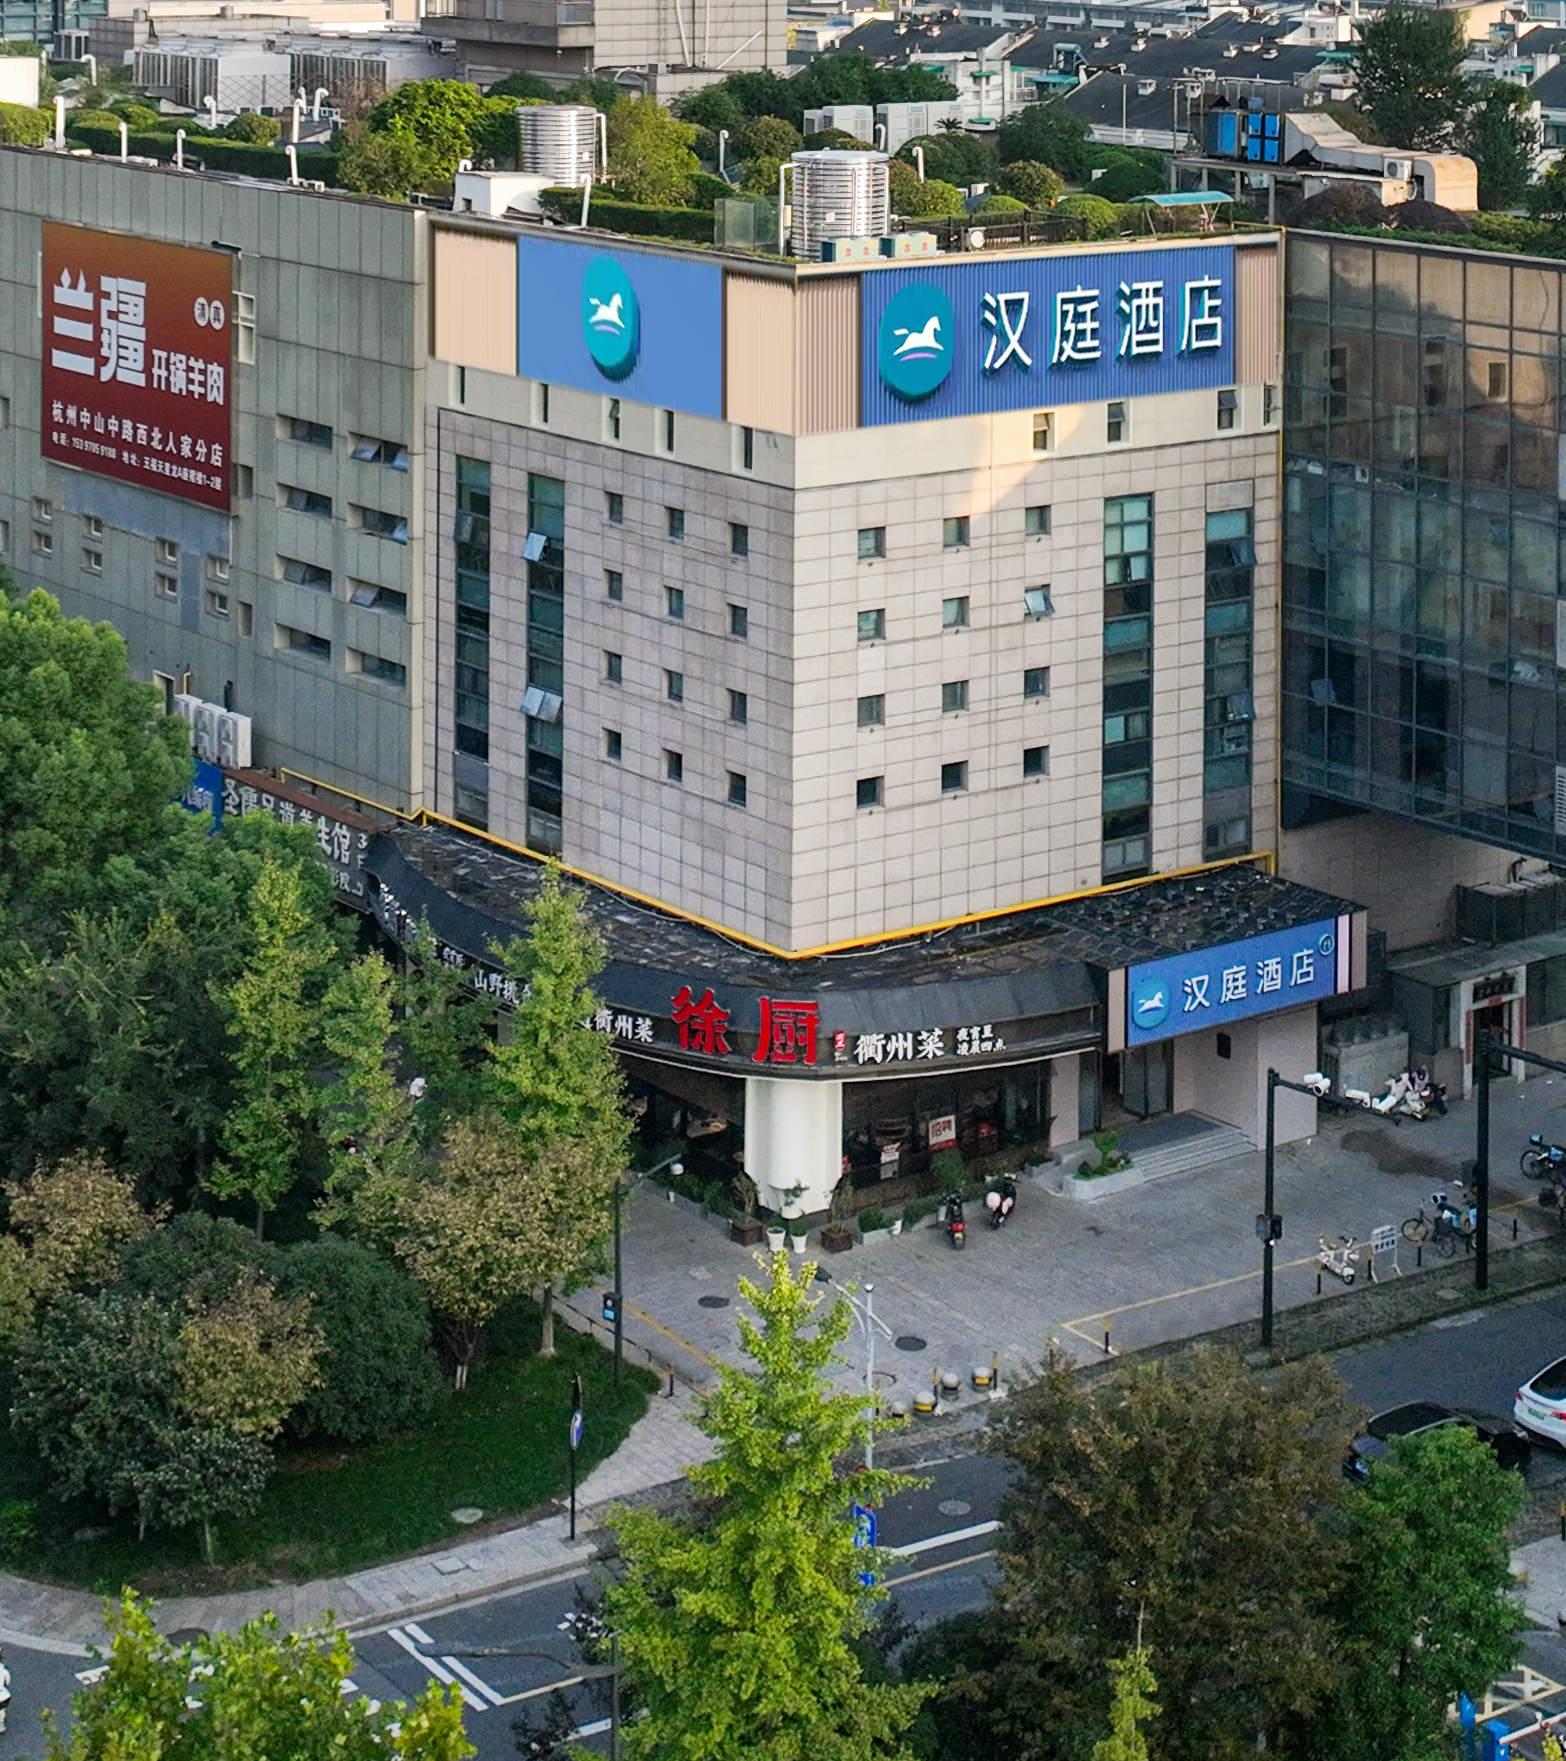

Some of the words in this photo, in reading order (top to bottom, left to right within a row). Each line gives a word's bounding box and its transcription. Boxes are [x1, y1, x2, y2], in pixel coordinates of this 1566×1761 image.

[196, 300, 223, 326] 清真
[982, 275, 1222, 369] 汉庭酒店
[151, 349, 224, 405] 开锅羊肉
[52, 399, 224, 468] 杭州中山中路西北人家分店
[1183, 949, 1315, 1013] 汉庭酒店
[672, 985, 820, 1066] 徐厨
[853, 1027, 946, 1065] 衢州菜
[956, 1038, 1006, 1056] 凌晨四点
